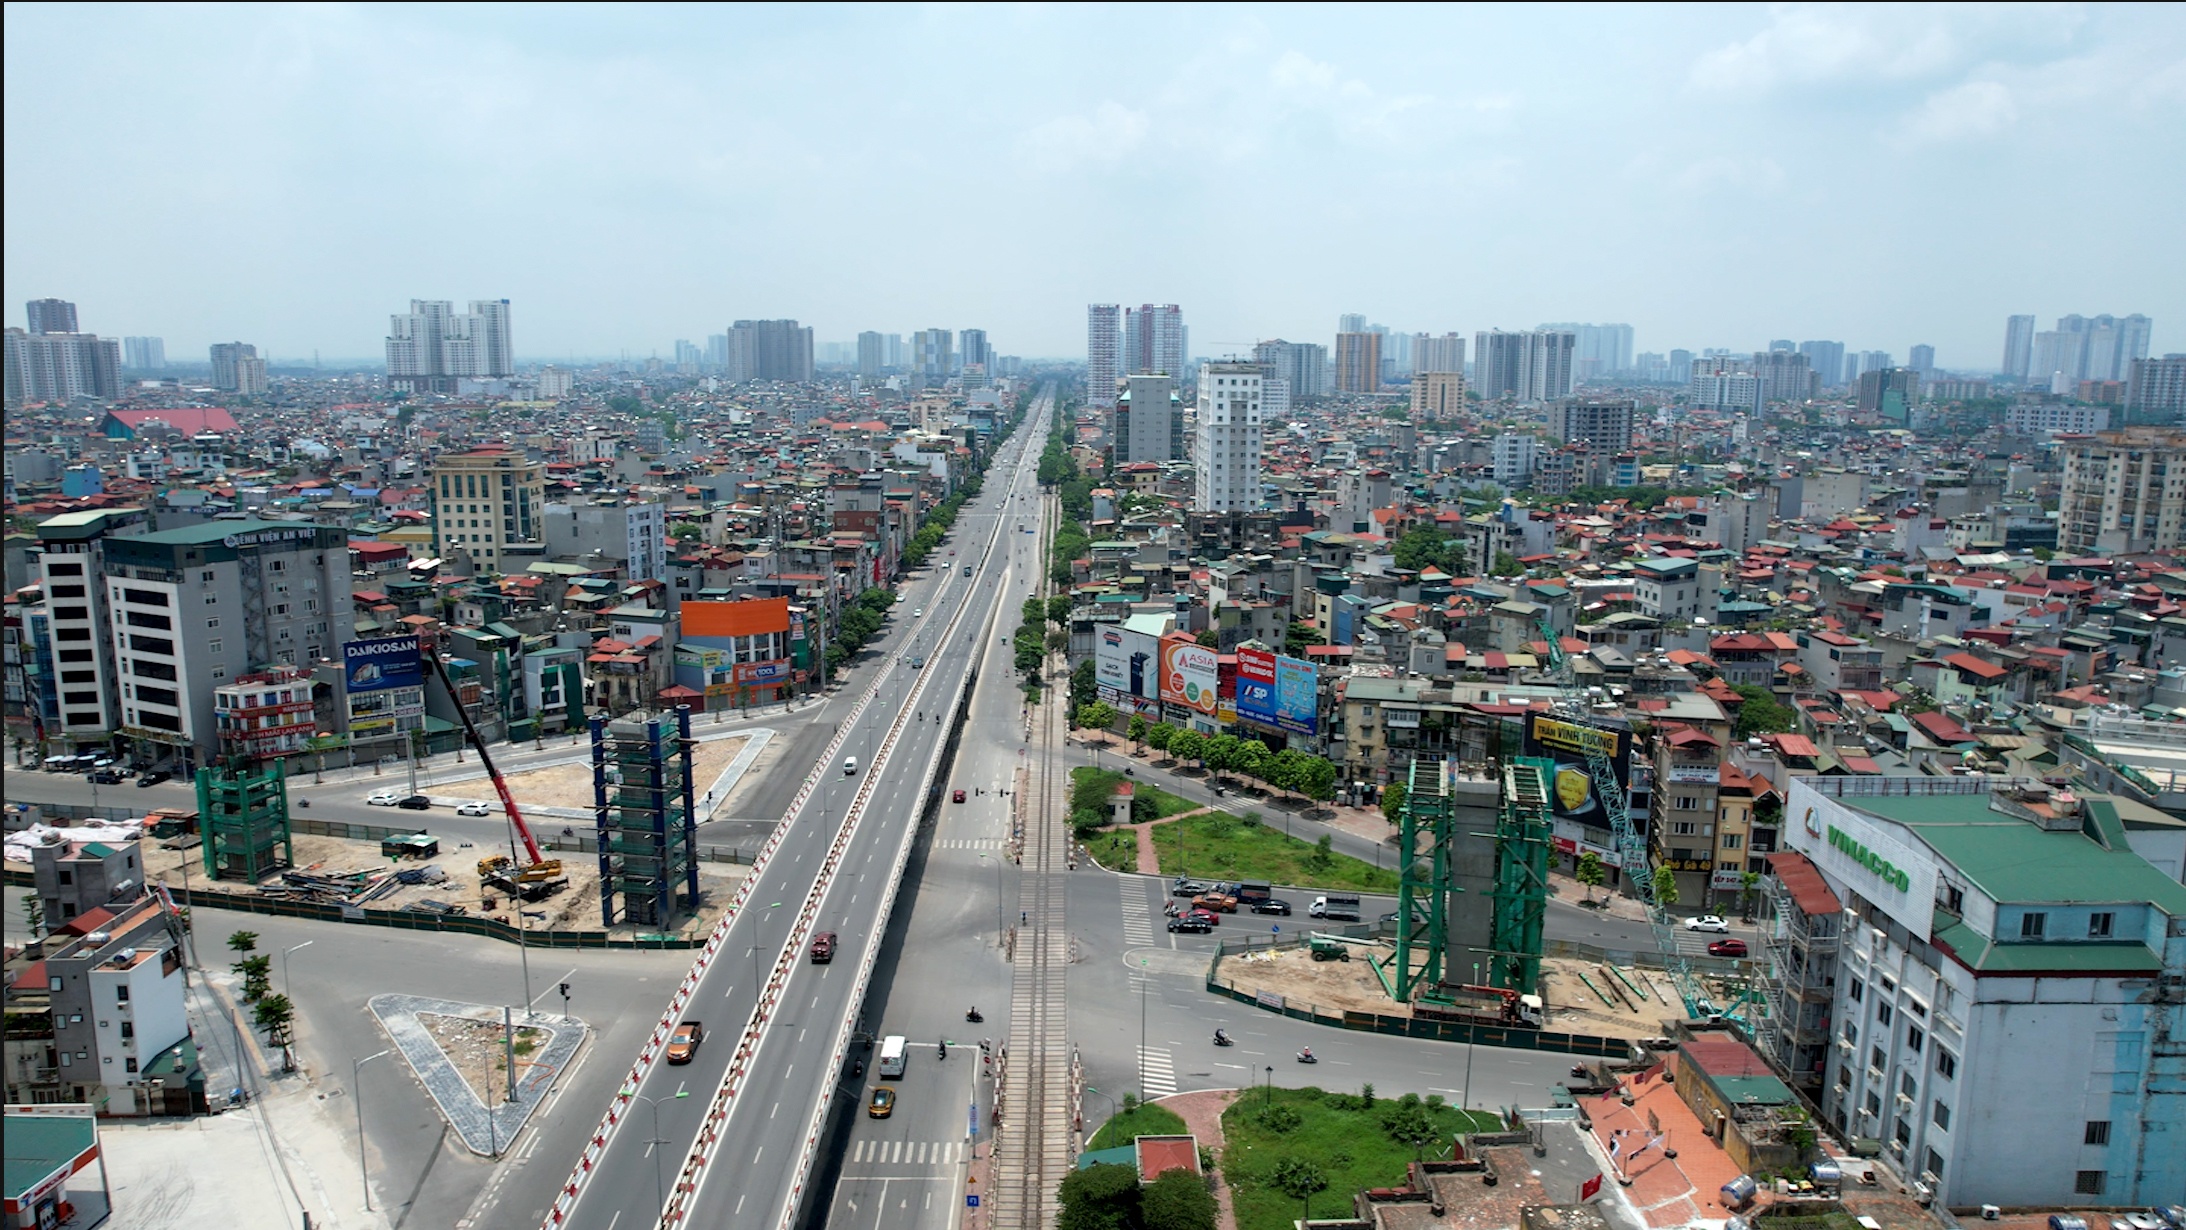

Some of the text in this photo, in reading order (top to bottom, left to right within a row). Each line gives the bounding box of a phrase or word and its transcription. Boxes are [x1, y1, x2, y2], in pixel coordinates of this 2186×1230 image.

[282, 530, 295, 540] AN
[347, 640, 417, 657] DAIKIOSAN
[1189, 653, 1214, 667] ASIA
[1828, 825, 1910, 893] VINACCO
